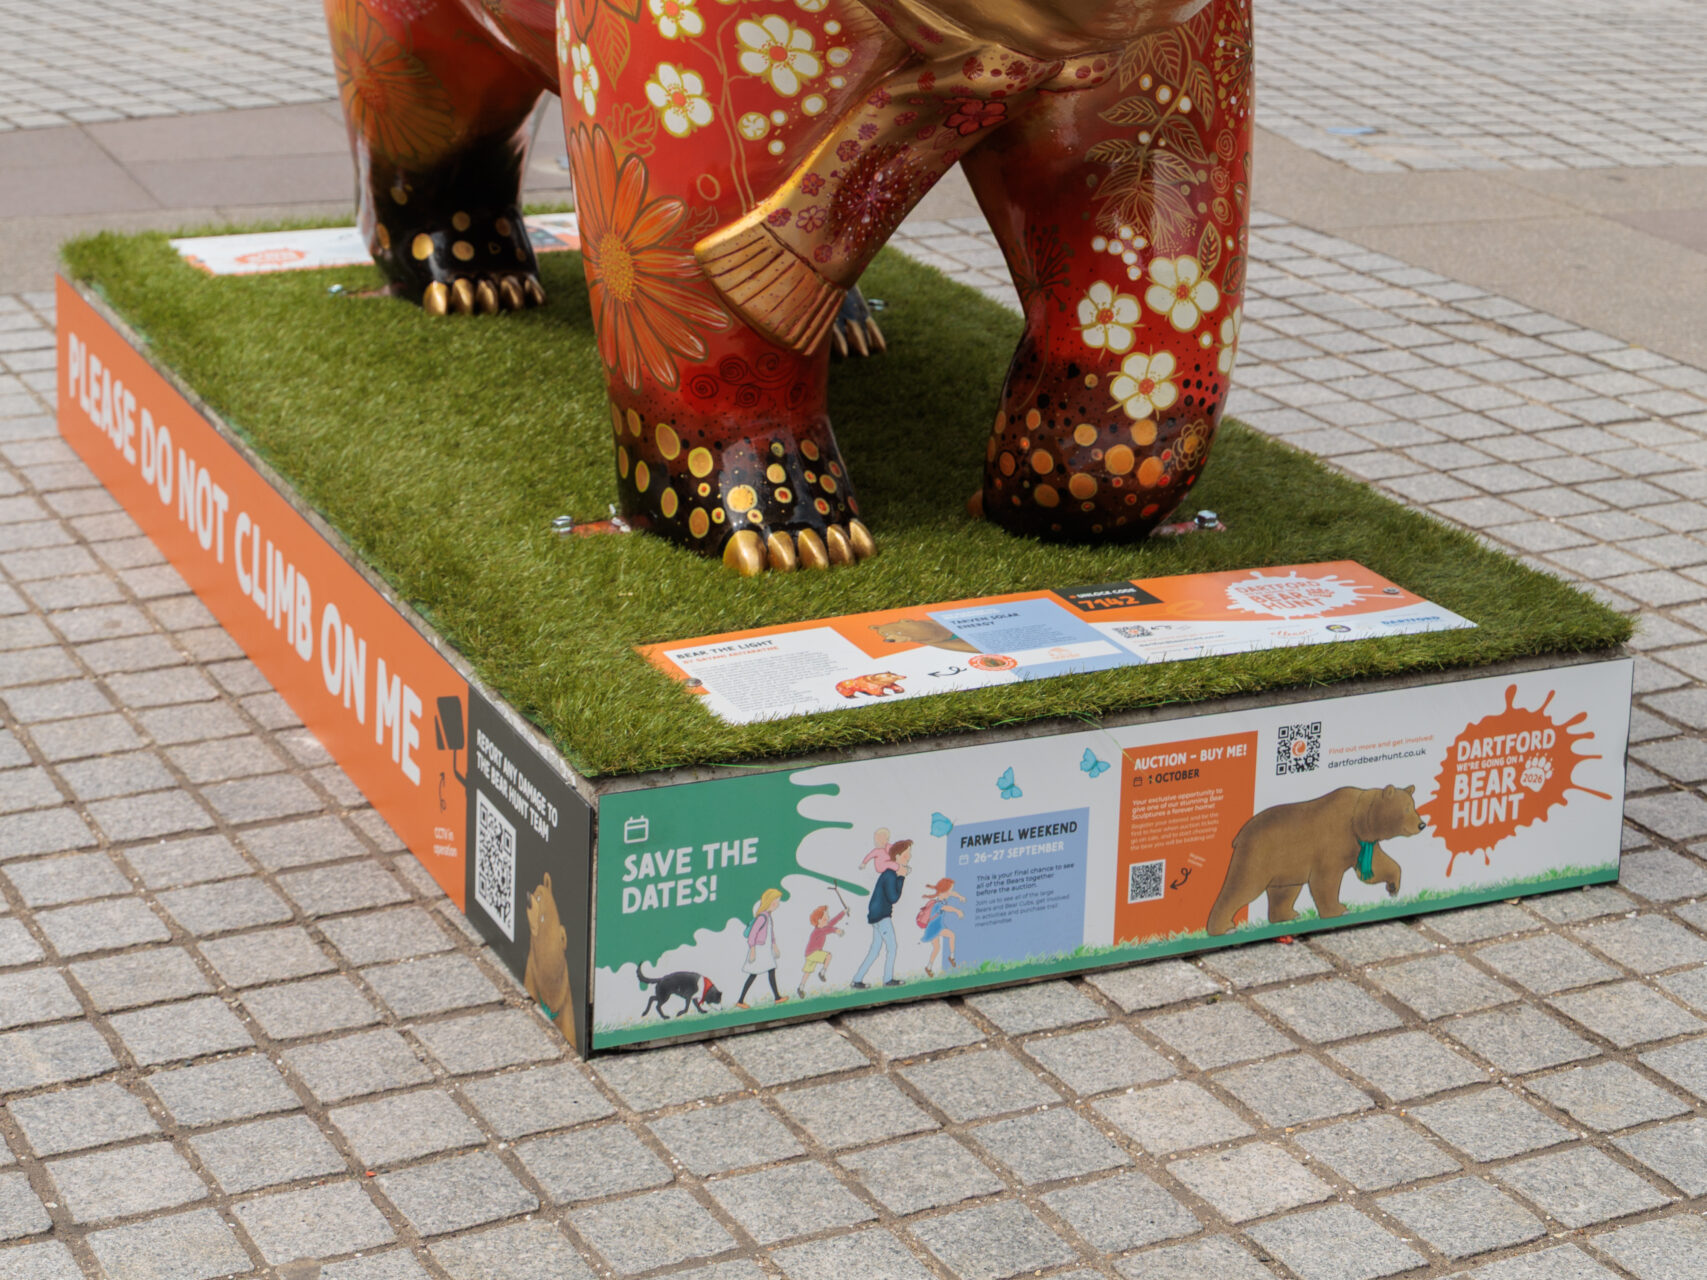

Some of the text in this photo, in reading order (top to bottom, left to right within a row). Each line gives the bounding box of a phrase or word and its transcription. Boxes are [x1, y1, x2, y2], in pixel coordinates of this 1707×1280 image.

[69, 332, 422, 786] PLEASE DO NOT CLIMB ON ME
[1078, 595, 1140, 609] 7142
[1261, 598, 1325, 610] HUNT
[738, 640, 773, 649] LIGHT
[1392, 739, 1402, 747] get
[1457, 729, 1556, 762] DARTFORD
[1134, 752, 1186, 771] AUCTION
[1200, 747, 1223, 762] BUY
[1227, 744, 1247, 759] ME!
[1328, 748, 1426, 769] dartfordbearhunt.co.uk
[1456, 761, 1480, 772] WE'RE
[1481, 757, 1504, 769] GOING
[1506, 756, 1517, 765] ON
[477, 728, 558, 827] REPORT ANY DAMAGE TO
[1155, 768, 1200, 784] OCTOBER
[1454, 766, 1516, 801] BEAR
[476, 751, 549, 842] THE BEAR HUNT TEAM
[1452, 792, 1525, 830] HUNT
[961, 821, 1078, 848] FARWELL WEEKEND
[622, 837, 759, 882] SAVE THE
[974, 841, 1064, 864] 26-27 SEPTEMBER
[1026, 873, 1054, 883] together
[1030, 866, 1053, 874] chance
[622, 875, 717, 914] DATES!
[976, 888, 997, 896] before
